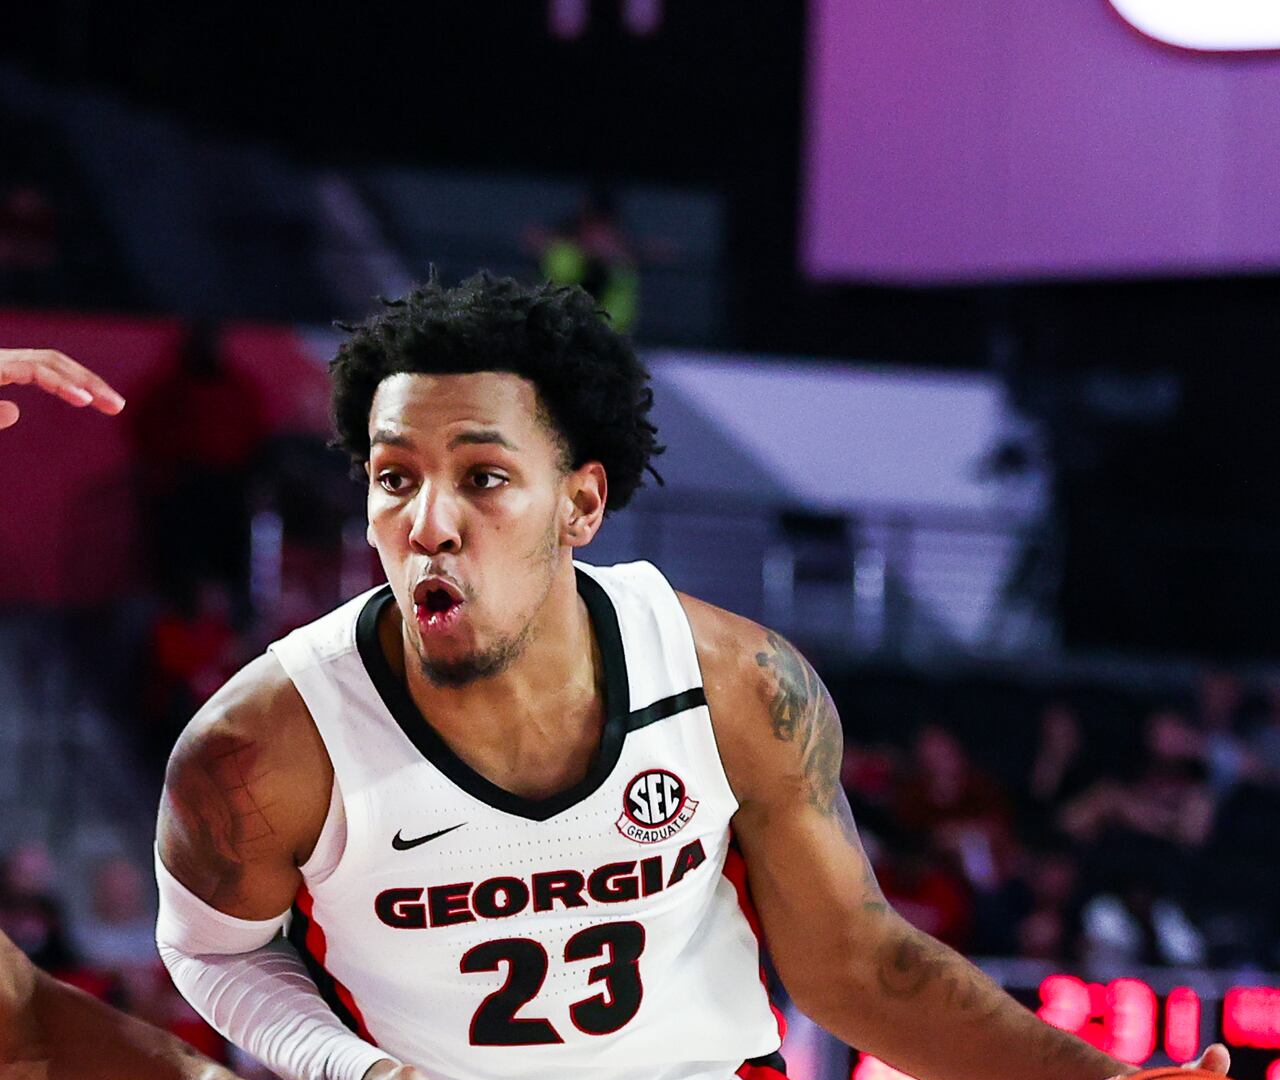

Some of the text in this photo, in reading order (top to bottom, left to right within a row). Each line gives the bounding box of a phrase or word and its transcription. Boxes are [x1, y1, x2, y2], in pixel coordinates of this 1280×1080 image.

[627, 813, 690, 842] GRADUATE
[628, 773, 680, 825] SEC
[374, 838, 707, 929] GEORGIA
[459, 920, 646, 1047] 23
